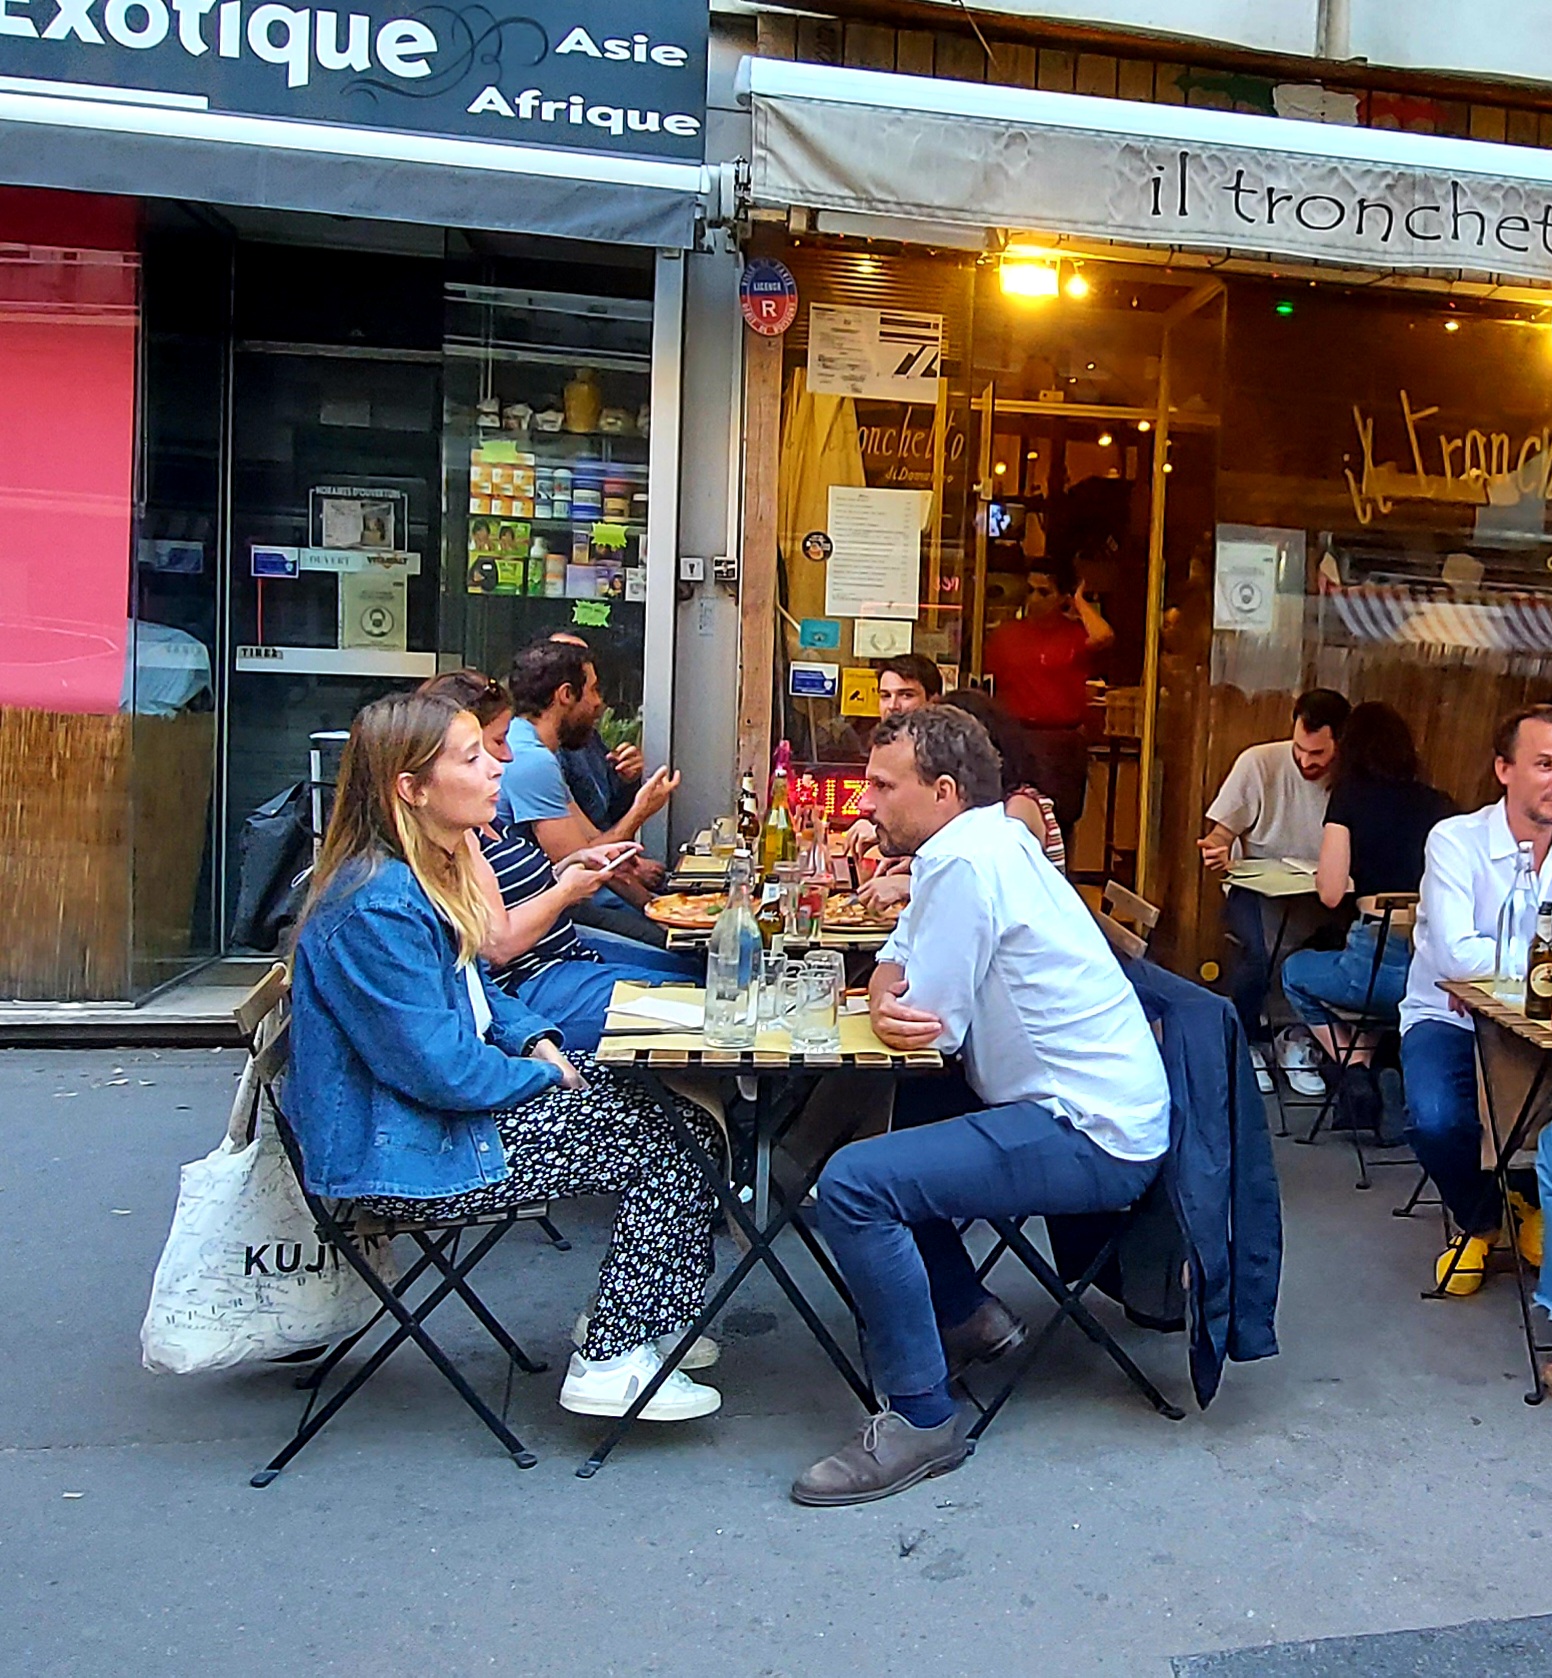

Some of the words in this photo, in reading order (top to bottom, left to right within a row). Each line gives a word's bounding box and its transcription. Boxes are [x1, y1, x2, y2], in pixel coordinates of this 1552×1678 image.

[555, 26, 688, 67] Asie
[467, 85, 702, 137] Afrique
[1151, 150, 1190, 216] il
[761, 299, 777, 318] R
